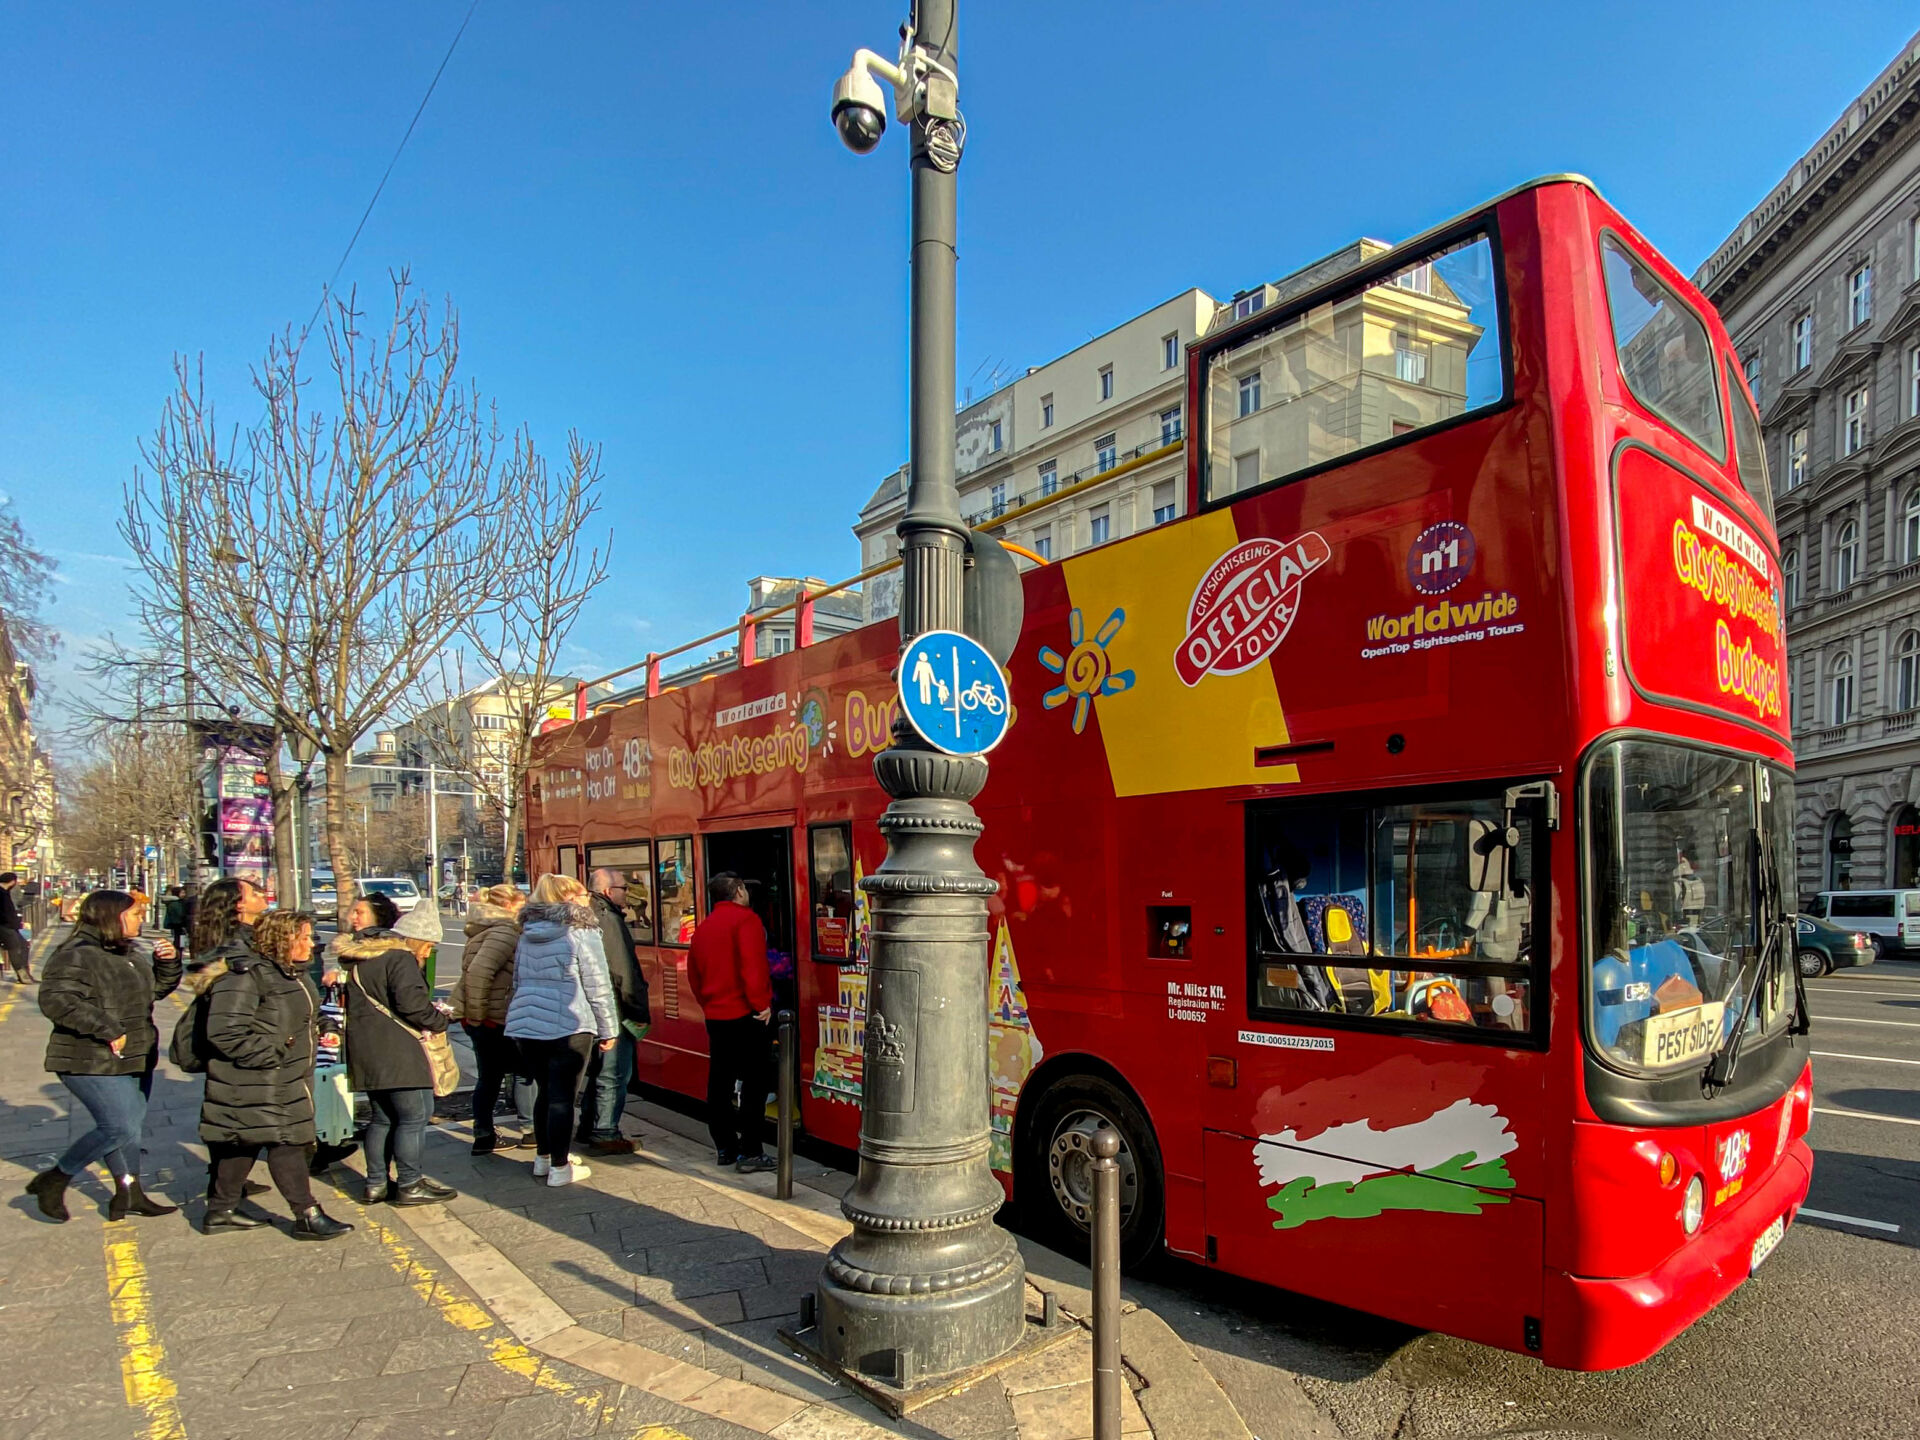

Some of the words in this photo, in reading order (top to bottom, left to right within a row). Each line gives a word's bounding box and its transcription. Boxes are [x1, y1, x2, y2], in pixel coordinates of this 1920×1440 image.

[1416, 522, 1464, 542] Operador
[1702, 504, 1768, 575] Worldwide
[1196, 544, 1270, 616] CITYSIGHTSEEING
[1415, 578, 1461, 595] Operator
[1188, 543, 1320, 668] OFFICIAL
[1367, 592, 1517, 641] Worldwide
[1234, 603, 1293, 663] TOUR
[1413, 630, 1484, 649] Sightseeing
[1487, 624, 1524, 637] Tours
[1716, 618, 1781, 718] Budapest
[721, 697, 784, 724] Worldwide
[586, 750, 601, 772] Hop
[602, 746, 614, 768] On
[623, 738, 640, 779] 48
[587, 780, 602, 800] Hop
[603, 776, 616, 797] Off
[1161, 890, 1173, 898] Fuel
[1167, 982, 1182, 996] Mr.
[1184, 983, 1208, 998] Nilsz
[1209, 985, 1226, 999] Kft.
[1168, 996, 1210, 1009] Registration
[1211, 1000, 1225, 1011] Nr.:
[1168, 1008, 1207, 1023] U-000652
[1240, 1033, 1255, 1042] ASZ
[1256, 1035, 1333, 1049] 01-000512/23/2015
[1657, 1027, 1690, 1062] PEST
[1689, 1018, 1714, 1052] SIDE
[1721, 1132, 1741, 1181] 48
